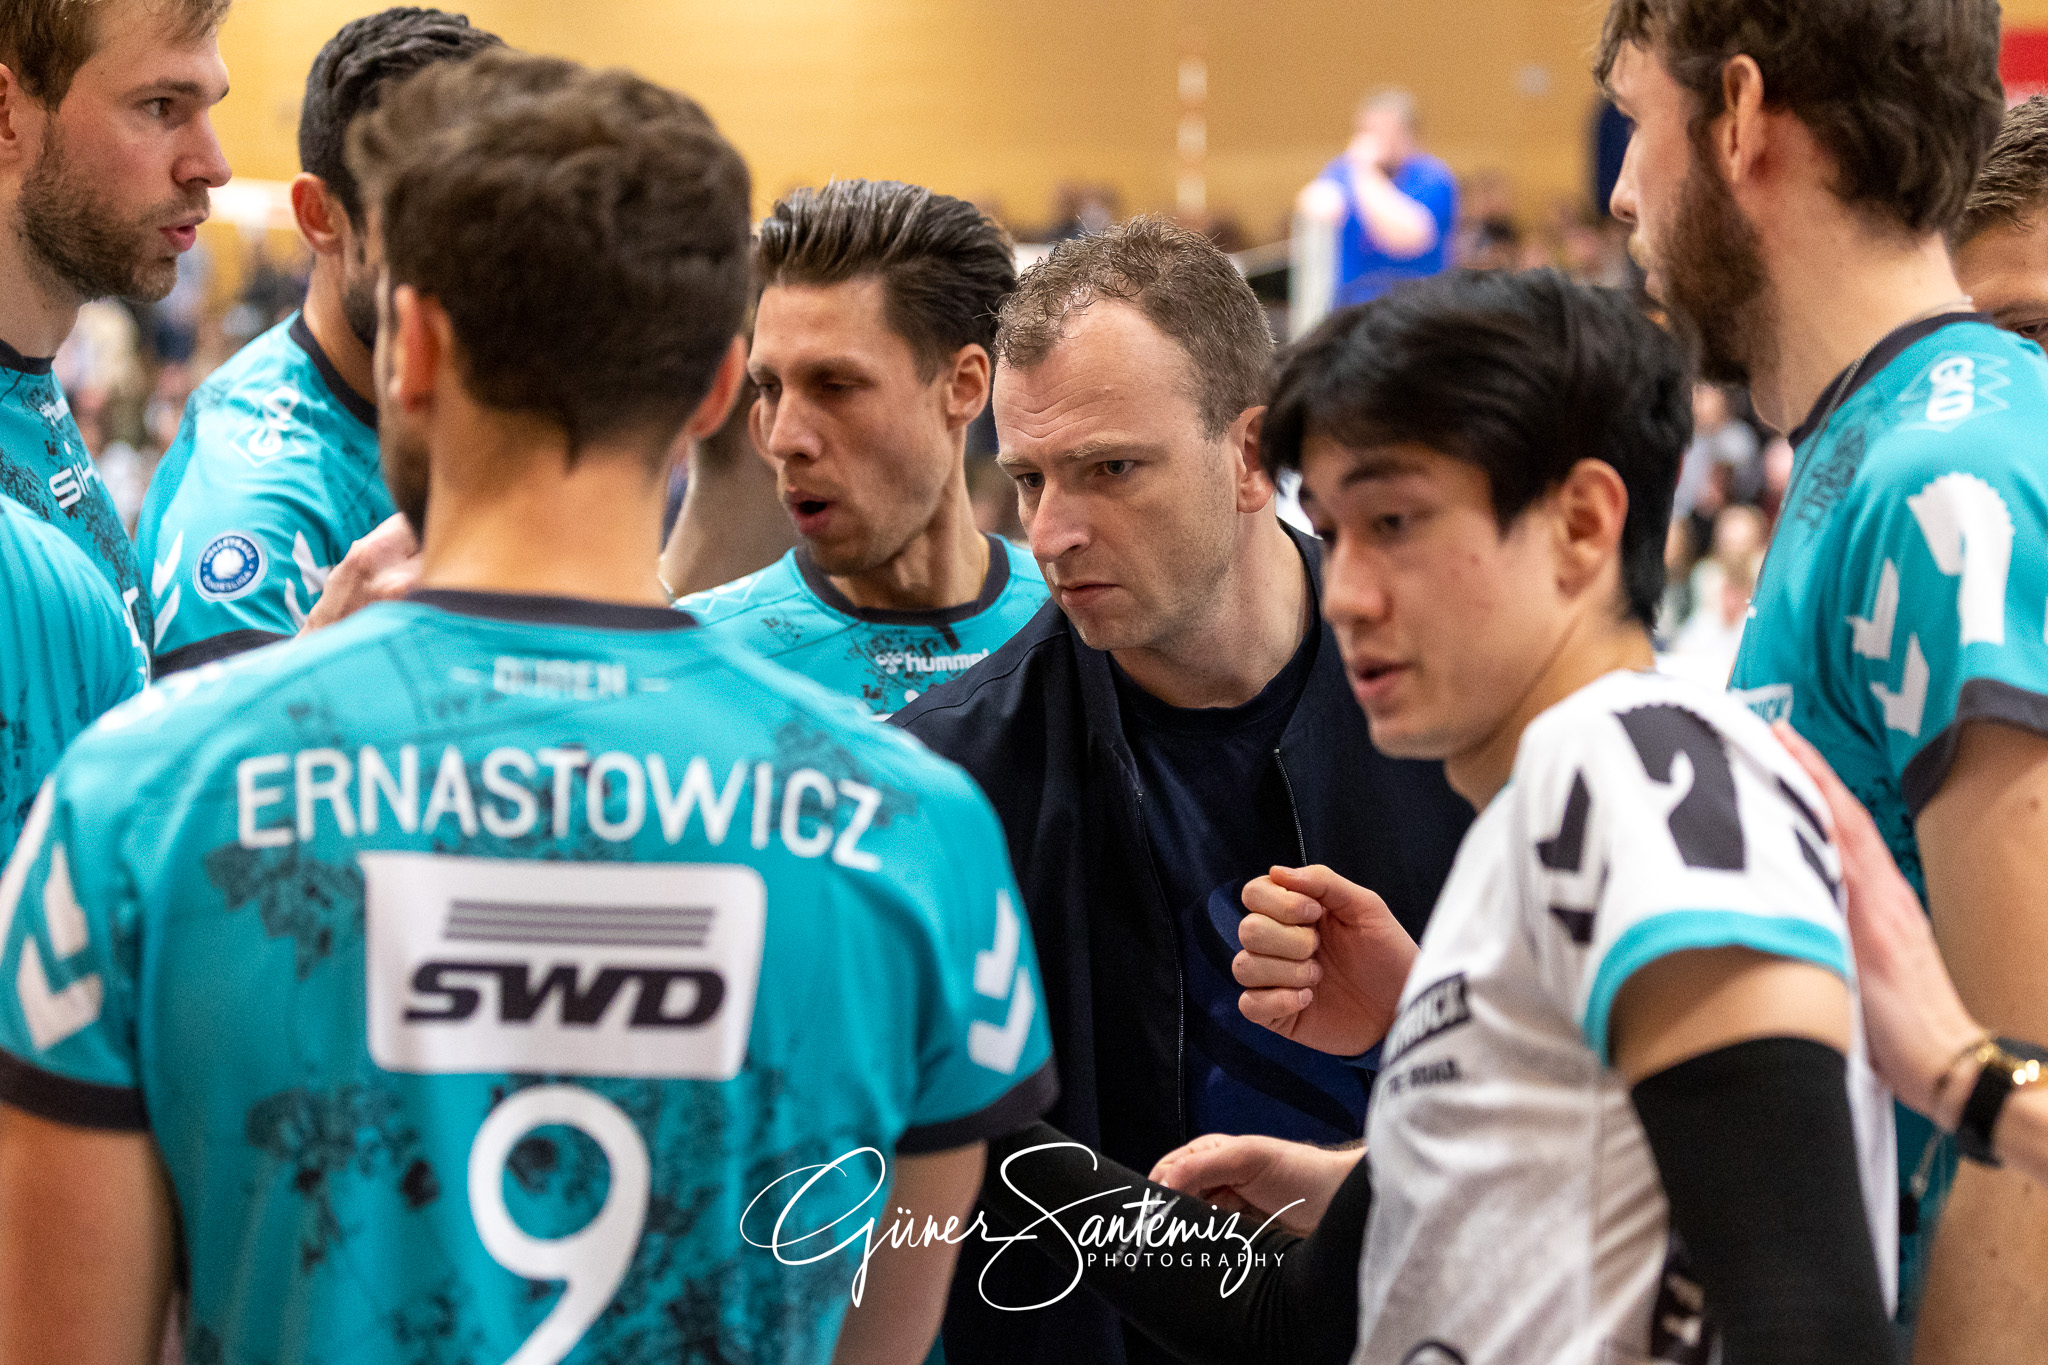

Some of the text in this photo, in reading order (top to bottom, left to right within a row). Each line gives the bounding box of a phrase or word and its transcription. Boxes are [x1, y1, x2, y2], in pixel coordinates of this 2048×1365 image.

[236, 744, 883, 873] ERNASTOWICZ
[403, 960, 728, 1031] SWD
[467, 1083, 650, 1365] 9
